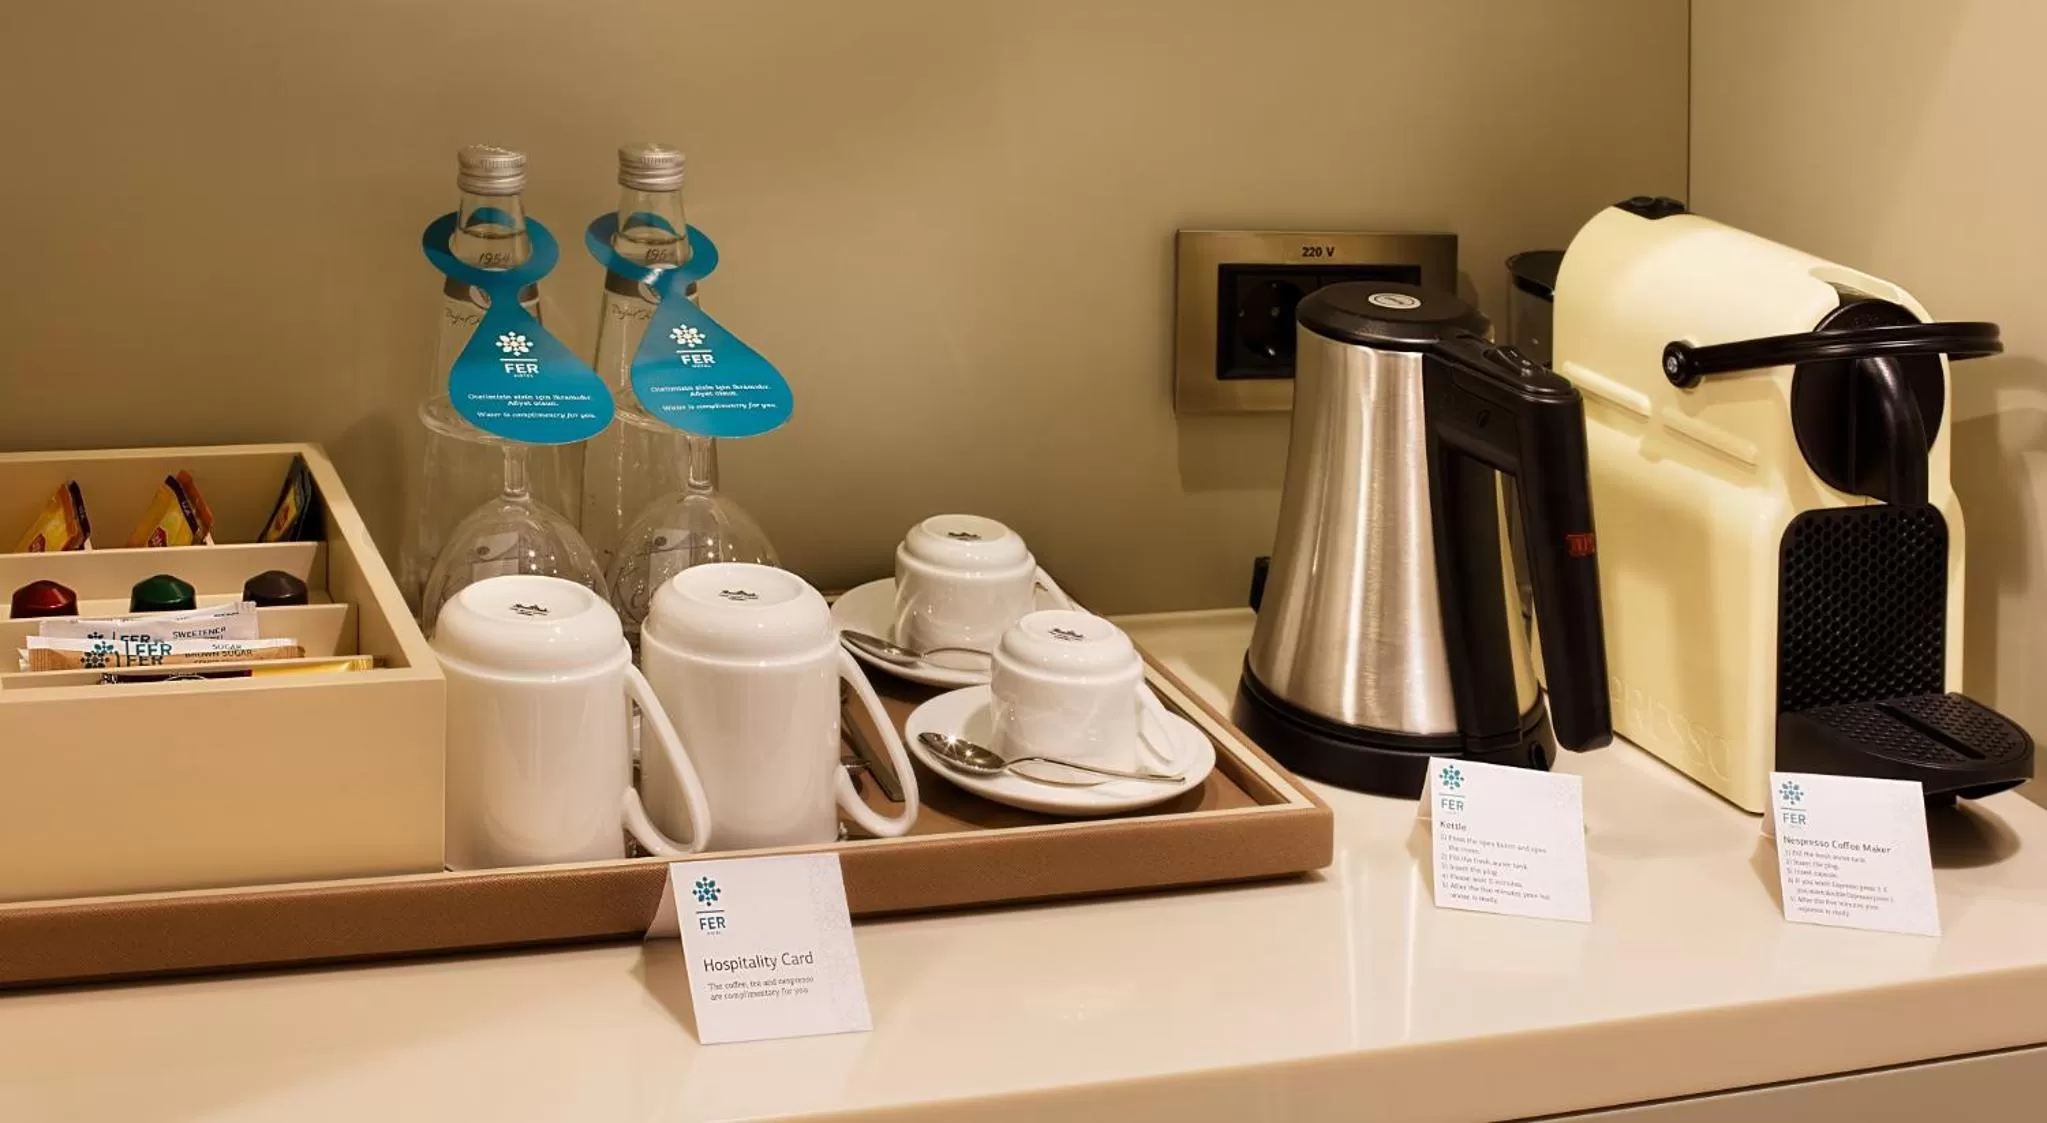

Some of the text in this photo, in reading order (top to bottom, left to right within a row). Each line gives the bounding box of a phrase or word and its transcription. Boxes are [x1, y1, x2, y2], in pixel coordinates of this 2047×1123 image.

[1302, 246, 1335, 258] 220 V
[681, 354, 716, 364] FER
[504, 363, 539, 374] FER
[135, 643, 173, 656] FER
[126, 656, 163, 667] FER
[1441, 798, 1464, 811] FER
[1783, 812, 1807, 825] FER
[1783, 836, 1892, 854] Nespresso Coffee Maker
[699, 916, 726, 931] FER
[703, 950, 814, 973] Hospitality Card
